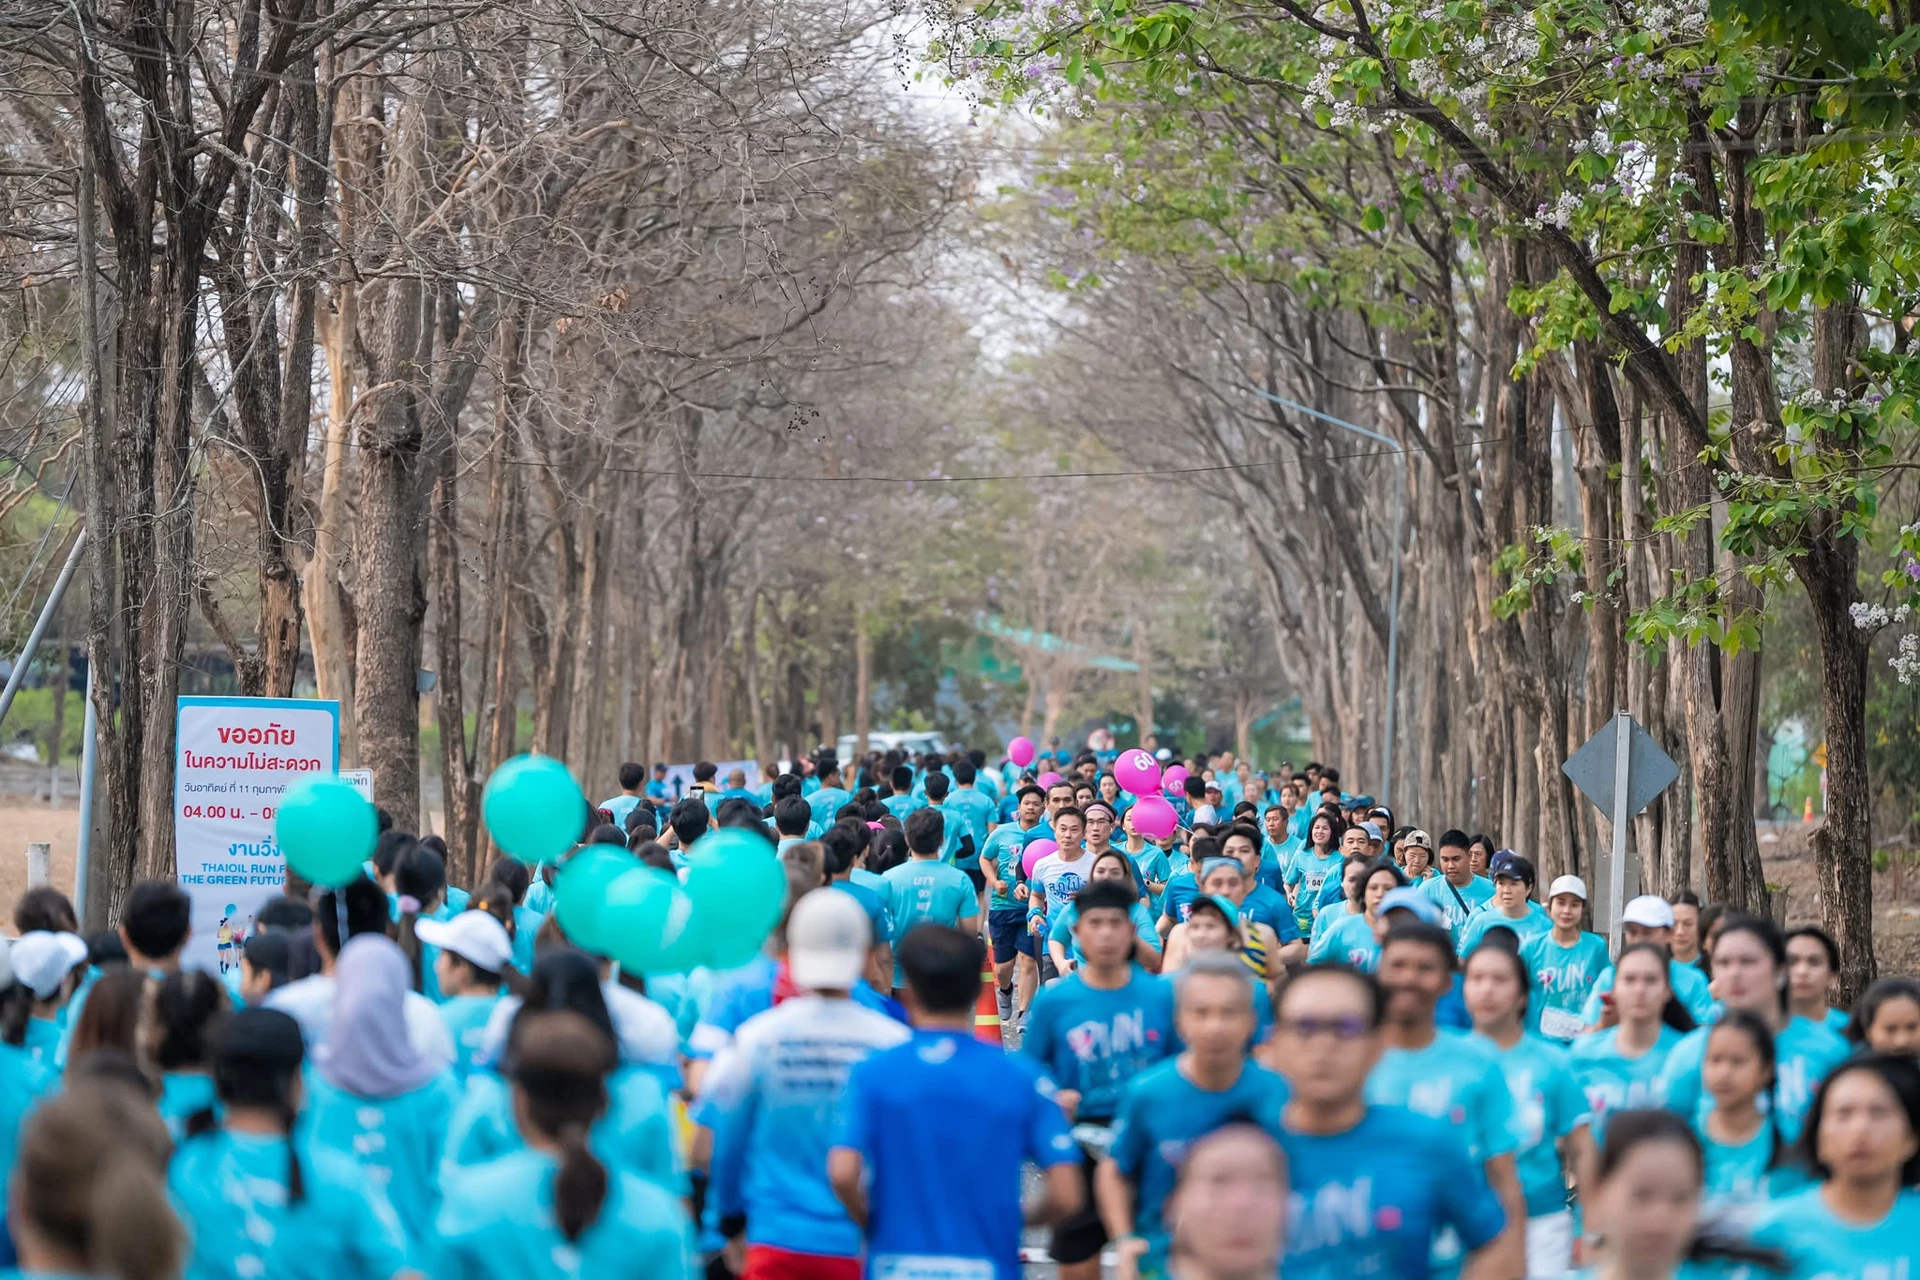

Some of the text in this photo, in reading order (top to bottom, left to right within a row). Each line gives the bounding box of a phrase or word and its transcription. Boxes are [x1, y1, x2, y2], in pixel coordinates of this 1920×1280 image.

[217, 723, 295, 745] ขออภัย
[185, 750, 321, 771] ในความไม่สะดวก
[1133, 752, 1155, 771] 60
[184, 782, 227, 793] วันอาทิตย์
[239, 785, 249, 793] 11
[252, 784, 287, 796] กุมภาพั
[183, 805, 226, 819] 04.00
[230, 808, 245, 819] น.
[262, 807, 278, 819] 08
[228, 834, 281, 857] งานวิ่ง
[201, 863, 248, 873] THAIOIL
[251, 864, 276, 874] RUN
[181, 875, 286, 885] THE GREEN FUTU
